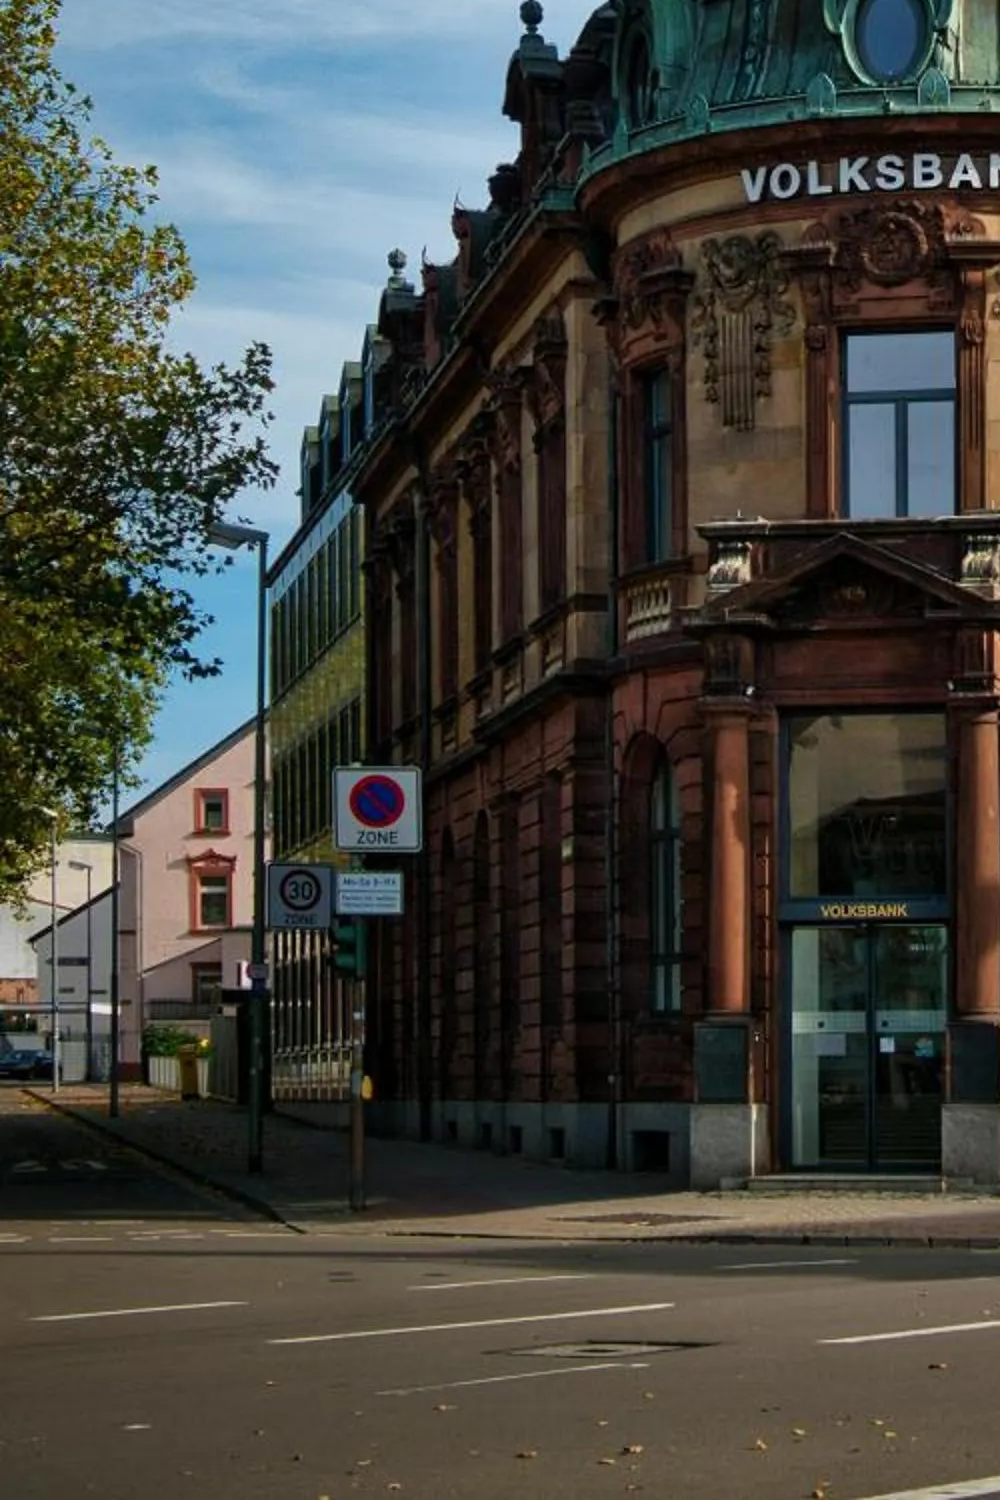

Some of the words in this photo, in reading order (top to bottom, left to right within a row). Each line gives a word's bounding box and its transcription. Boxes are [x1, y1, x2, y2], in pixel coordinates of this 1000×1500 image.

[357, 831, 398, 844] ZONE
[289, 881, 313, 901] 30
[820, 904, 908, 917] VOLKSBANK
[284, 913, 317, 925] ZONE
